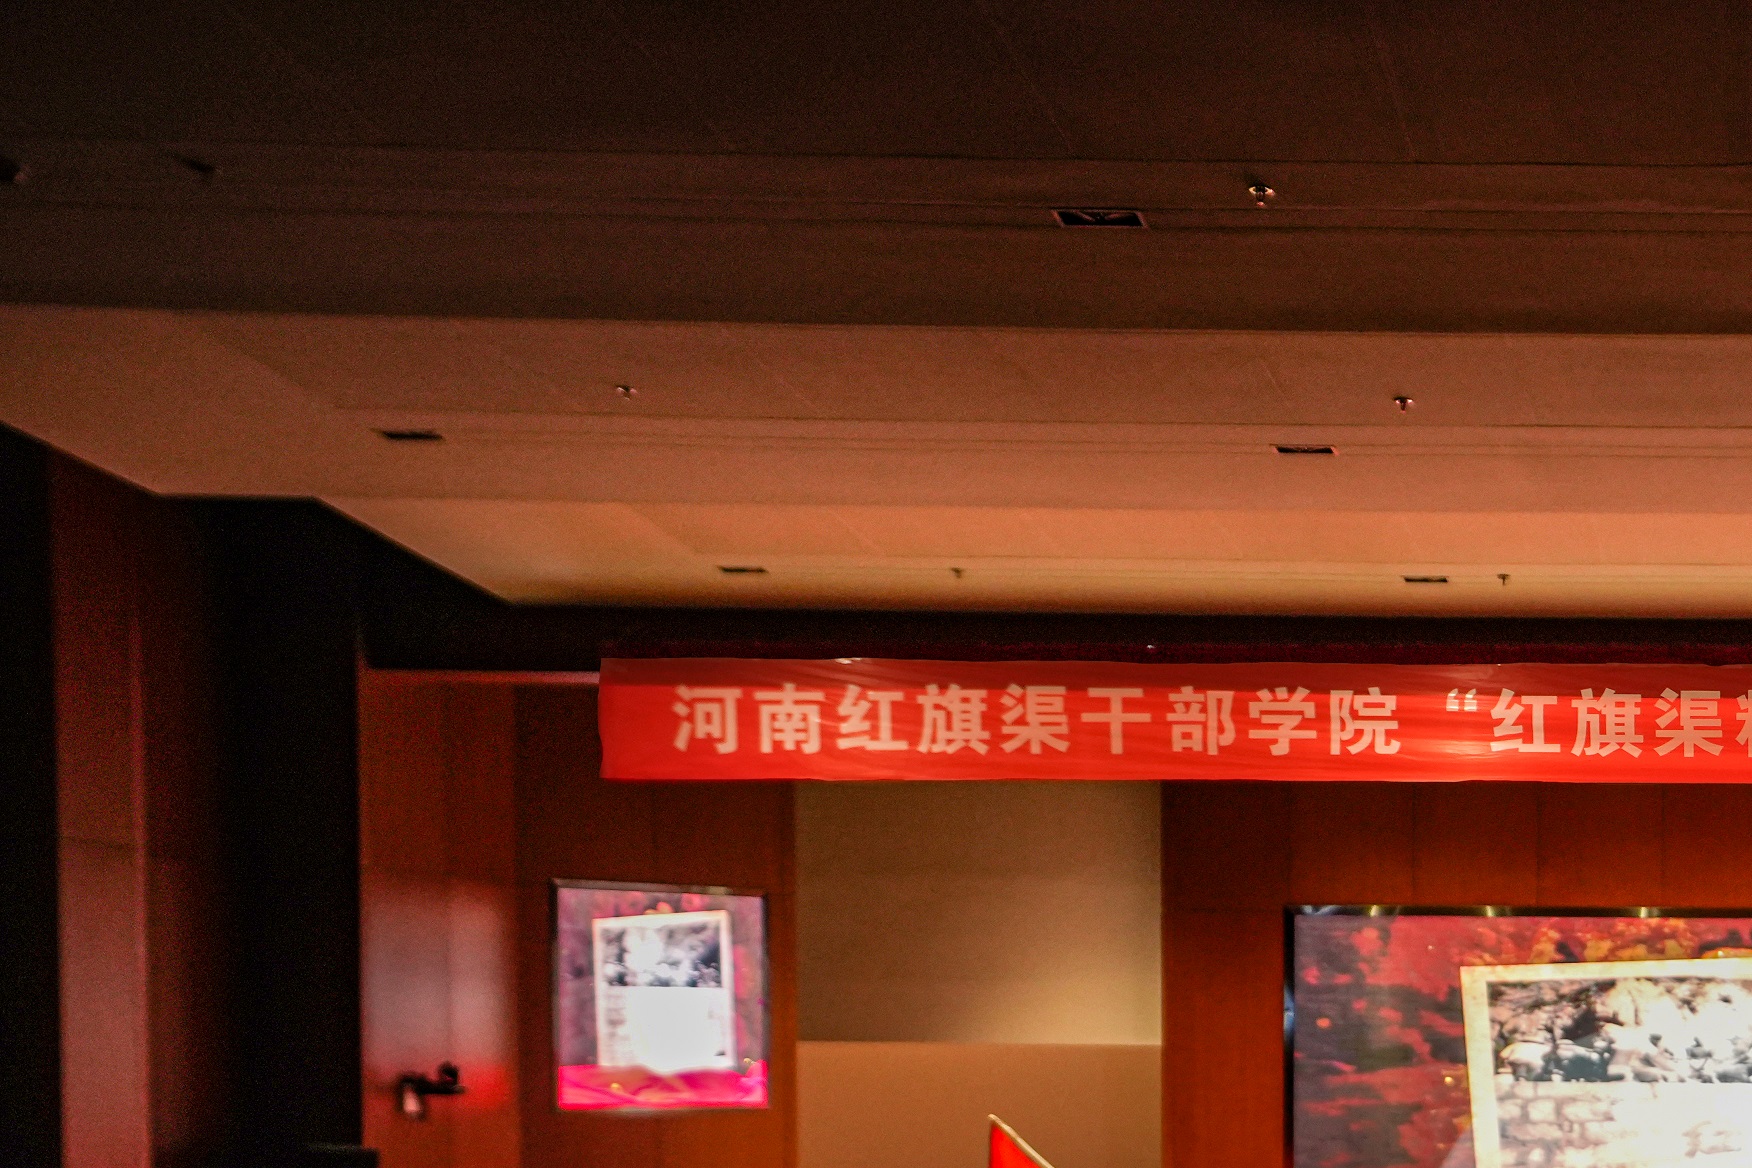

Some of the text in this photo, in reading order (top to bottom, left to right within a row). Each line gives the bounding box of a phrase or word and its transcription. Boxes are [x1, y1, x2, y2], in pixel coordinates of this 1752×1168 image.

[672, 682, 1402, 757] 河南红旗渠干部学院
